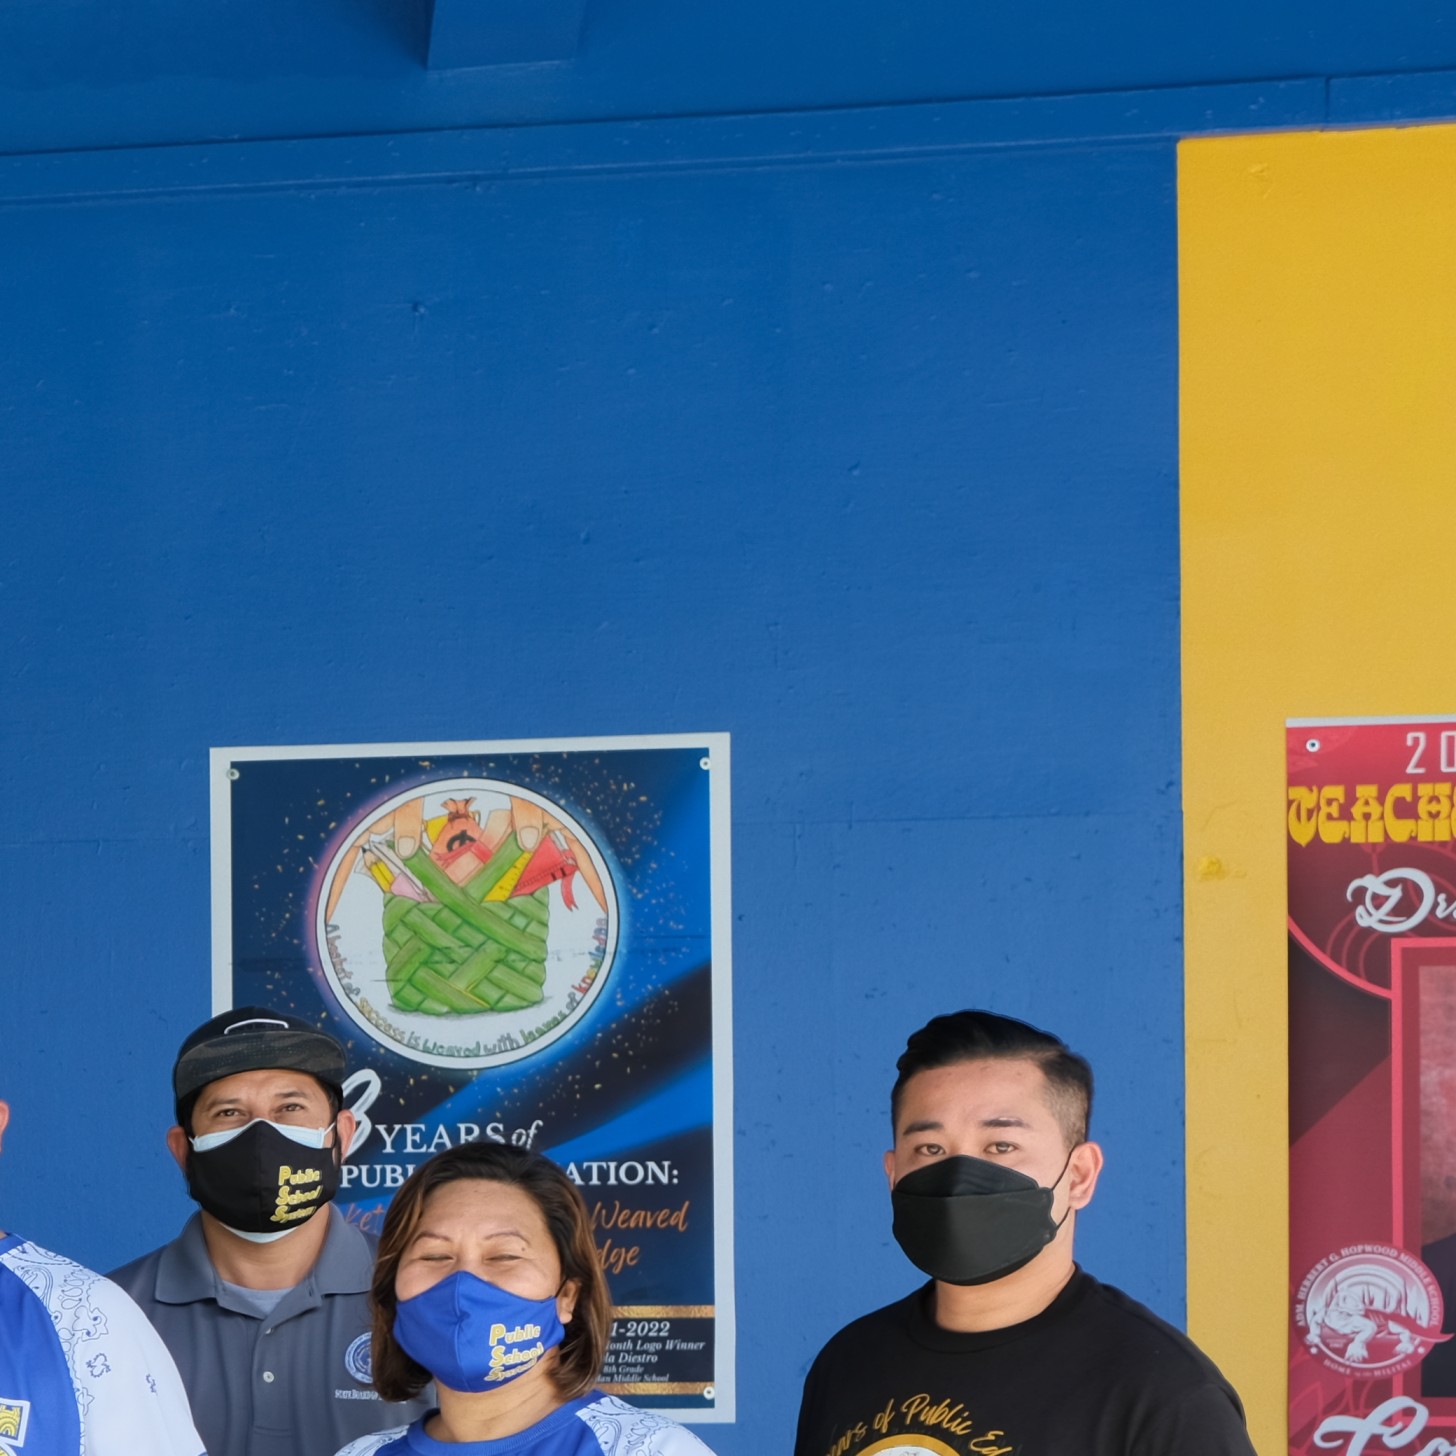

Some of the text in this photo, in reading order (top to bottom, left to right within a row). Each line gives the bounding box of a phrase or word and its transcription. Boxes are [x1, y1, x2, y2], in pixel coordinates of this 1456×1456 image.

[1288, 782, 1456, 847] TEACH
[375, 1123, 505, 1154] YEARS
[278, 1166, 320, 1186] Public
[340, 1164, 416, 1188] PUB
[566, 1161, 679, 1185] ATION:
[275, 1186, 322, 1205] School
[1341, 1244, 1398, 1258] HOPWOOD
[1399, 1253, 1432, 1283] MIDDLE
[489, 1324, 541, 1346] Public
[611, 1321, 670, 1337] 1-2022
[489, 1342, 544, 1367] School
[637, 1340, 662, 1352] Logo
[666, 1340, 705, 1350] Winner
[619, 1352, 658, 1363] Diestro
[603, 1365, 617, 1373] 8th
[613, 1374, 640, 1382] Middle
[643, 1374, 669, 1382] School
[873, 1398, 895, 1433] of
[901, 1393, 972, 1435] Public
